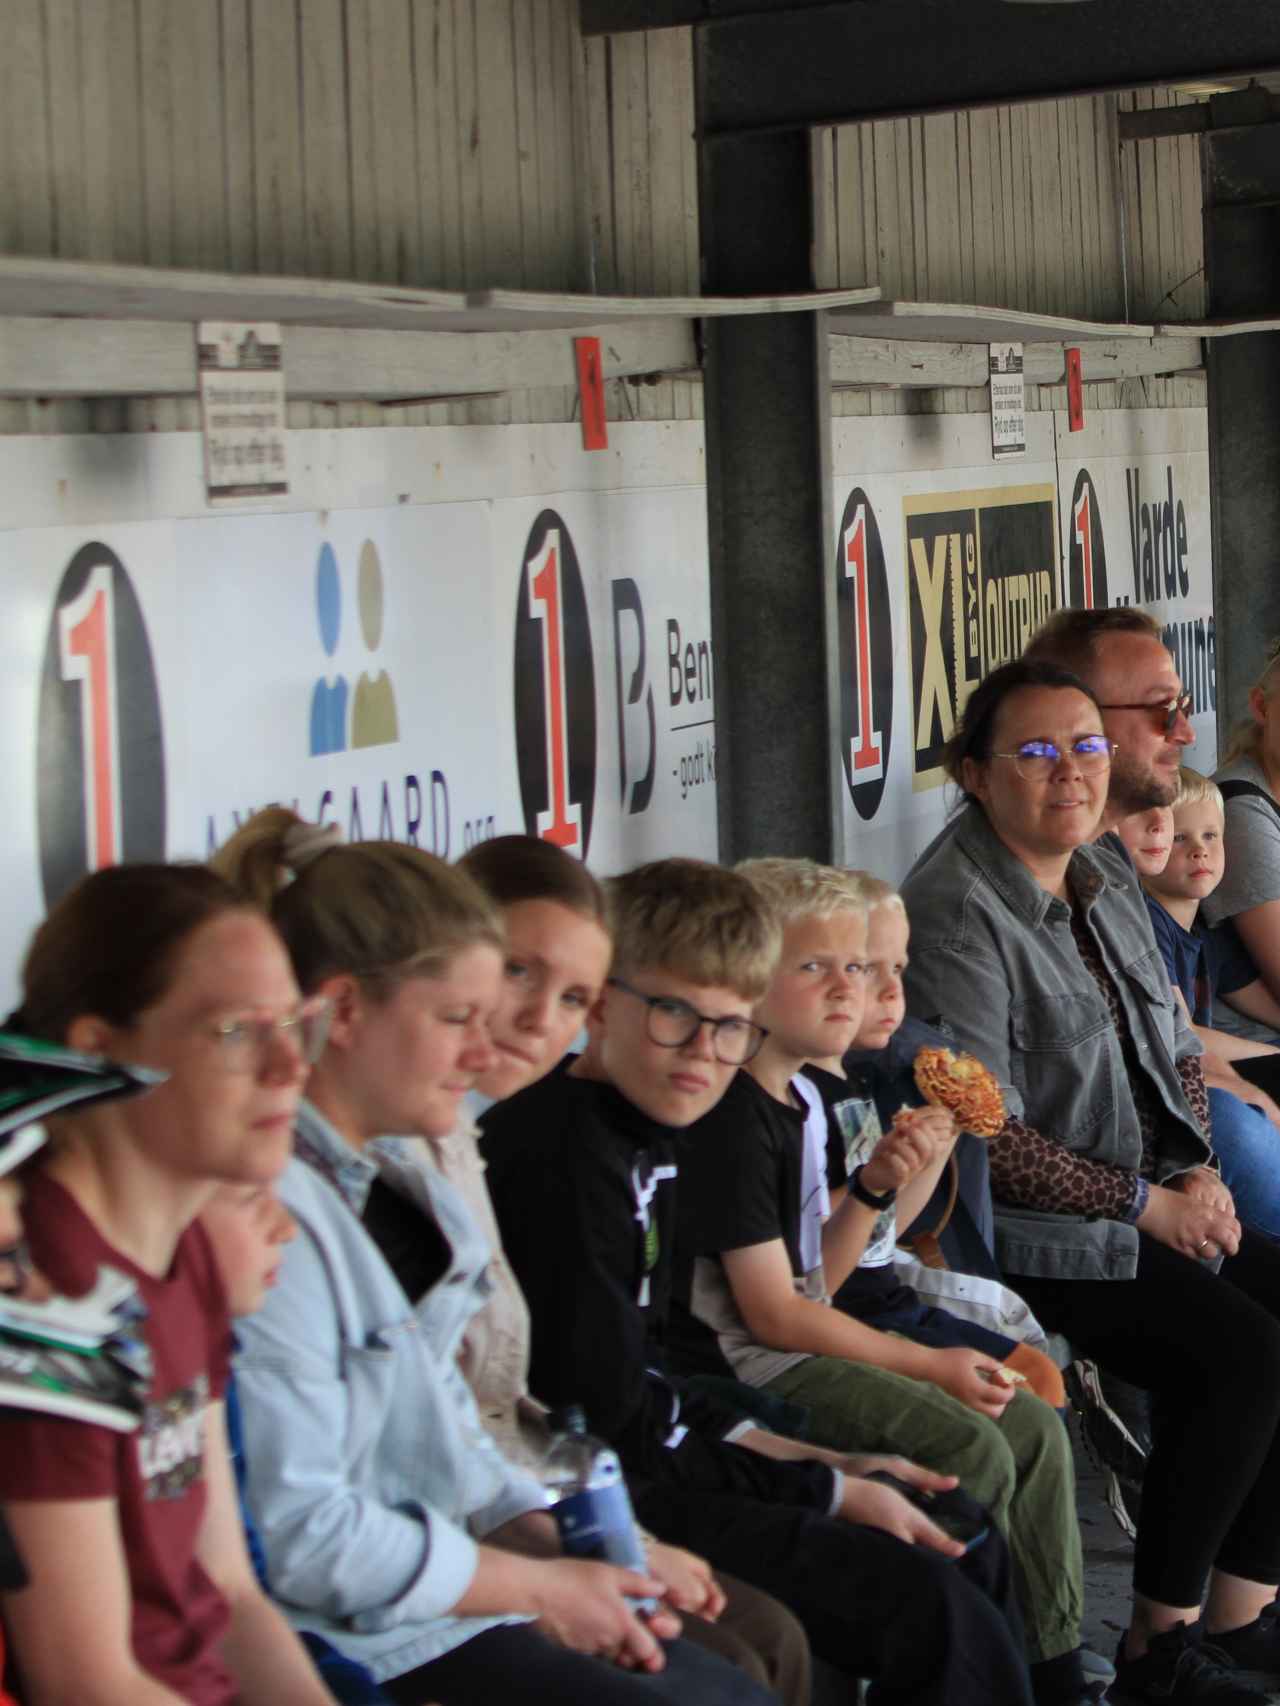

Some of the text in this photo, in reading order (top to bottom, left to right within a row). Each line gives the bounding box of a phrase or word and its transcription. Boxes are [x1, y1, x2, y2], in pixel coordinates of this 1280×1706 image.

[1075, 482, 1095, 608] 1
[1126, 464, 1190, 604] Varde
[59, 565, 122, 871] 1
[528, 529, 583, 859] 1
[667, 618, 713, 706] Ben
[844, 504, 883, 786] 1
